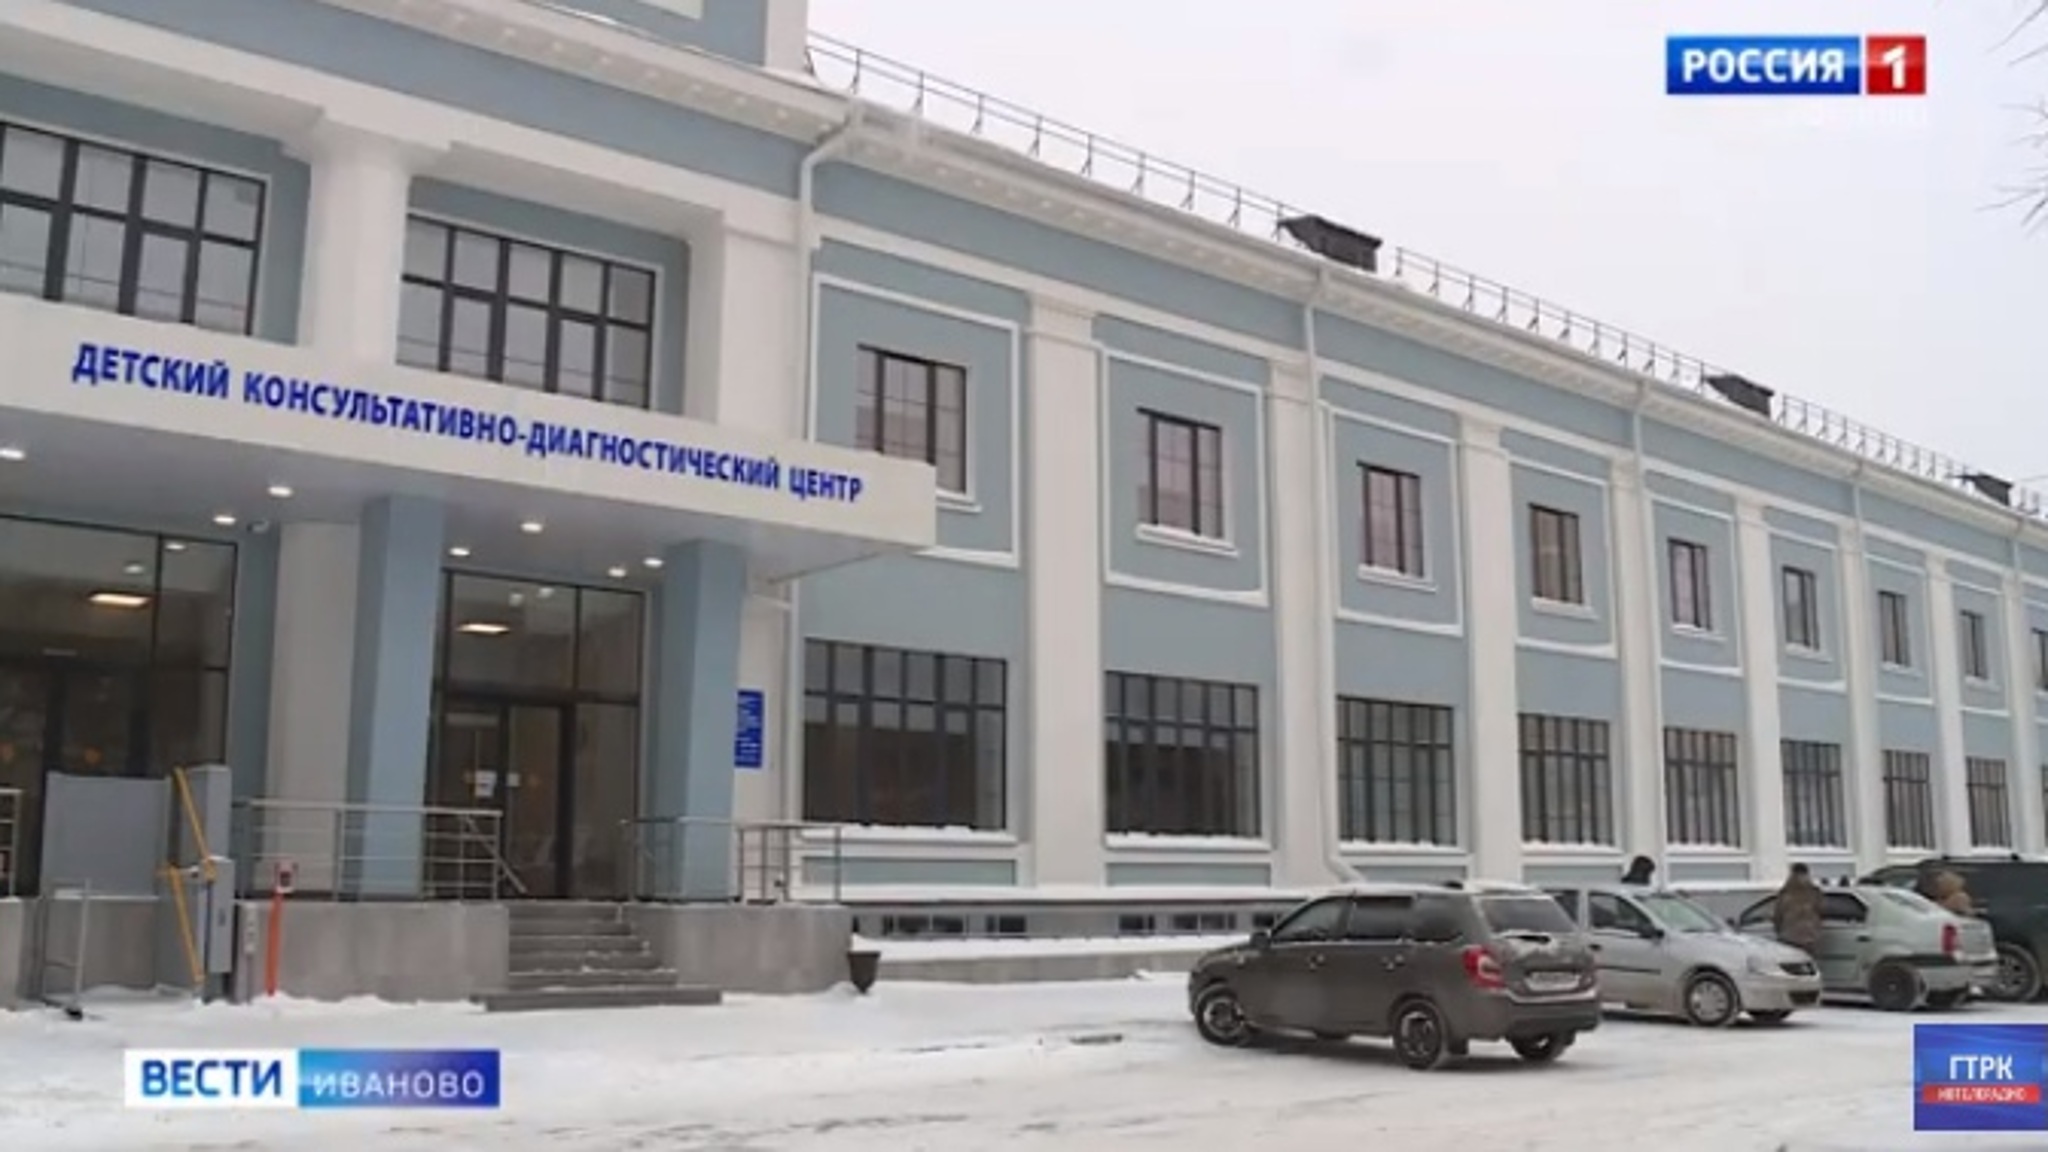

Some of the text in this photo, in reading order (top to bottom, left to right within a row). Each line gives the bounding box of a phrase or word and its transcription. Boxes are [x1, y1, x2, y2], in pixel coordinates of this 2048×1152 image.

[71, 343, 863, 503] ДЕТСКИЙ КОНСУЛЬТАТИВНО-ДИАГНОСТИЧЕСКИЙ ЦЕНТР
